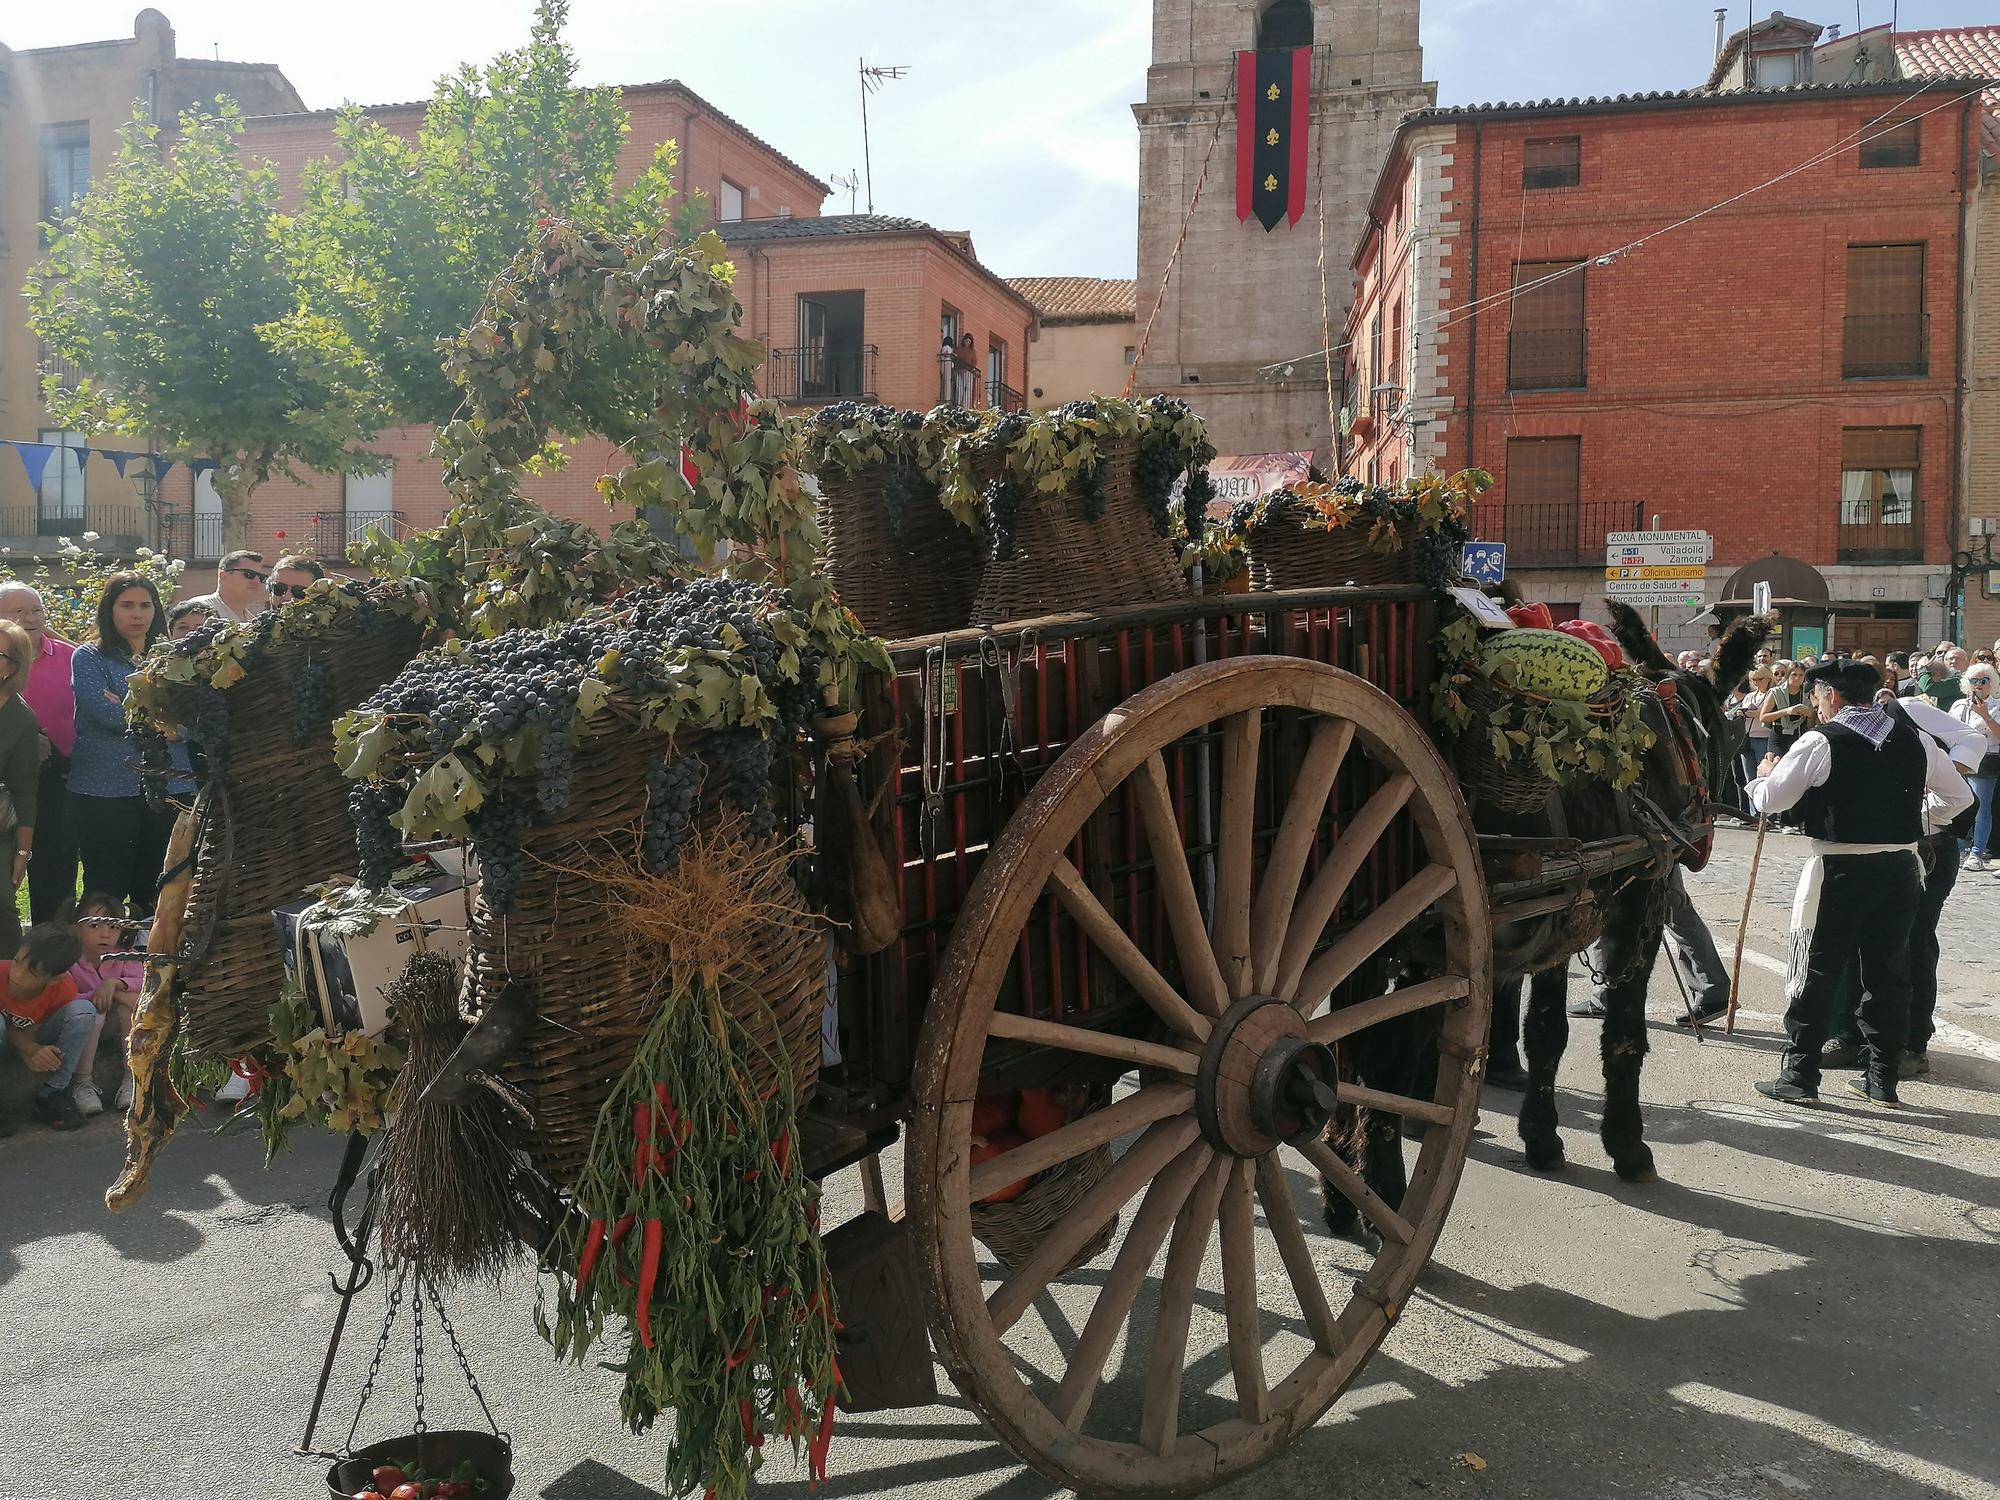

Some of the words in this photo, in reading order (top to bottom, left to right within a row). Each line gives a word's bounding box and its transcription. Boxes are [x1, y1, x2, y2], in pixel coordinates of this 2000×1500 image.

[1610, 534, 1636, 542] ZONA
[1638, 531, 1702, 541] MONUMENTAL
[1660, 545, 1704, 555] Valladolid
[1669, 555, 1703, 563] Zamora
[1643, 568, 1670, 577] Oficina
[1671, 568, 1703, 576] Turismo
[1609, 581, 1638, 590] Centro
[1640, 581, 1650, 590] de
[1653, 580, 1677, 589] Salud
[1644, 595, 1654, 603] de
[1476, 597, 1498, 617] 4
